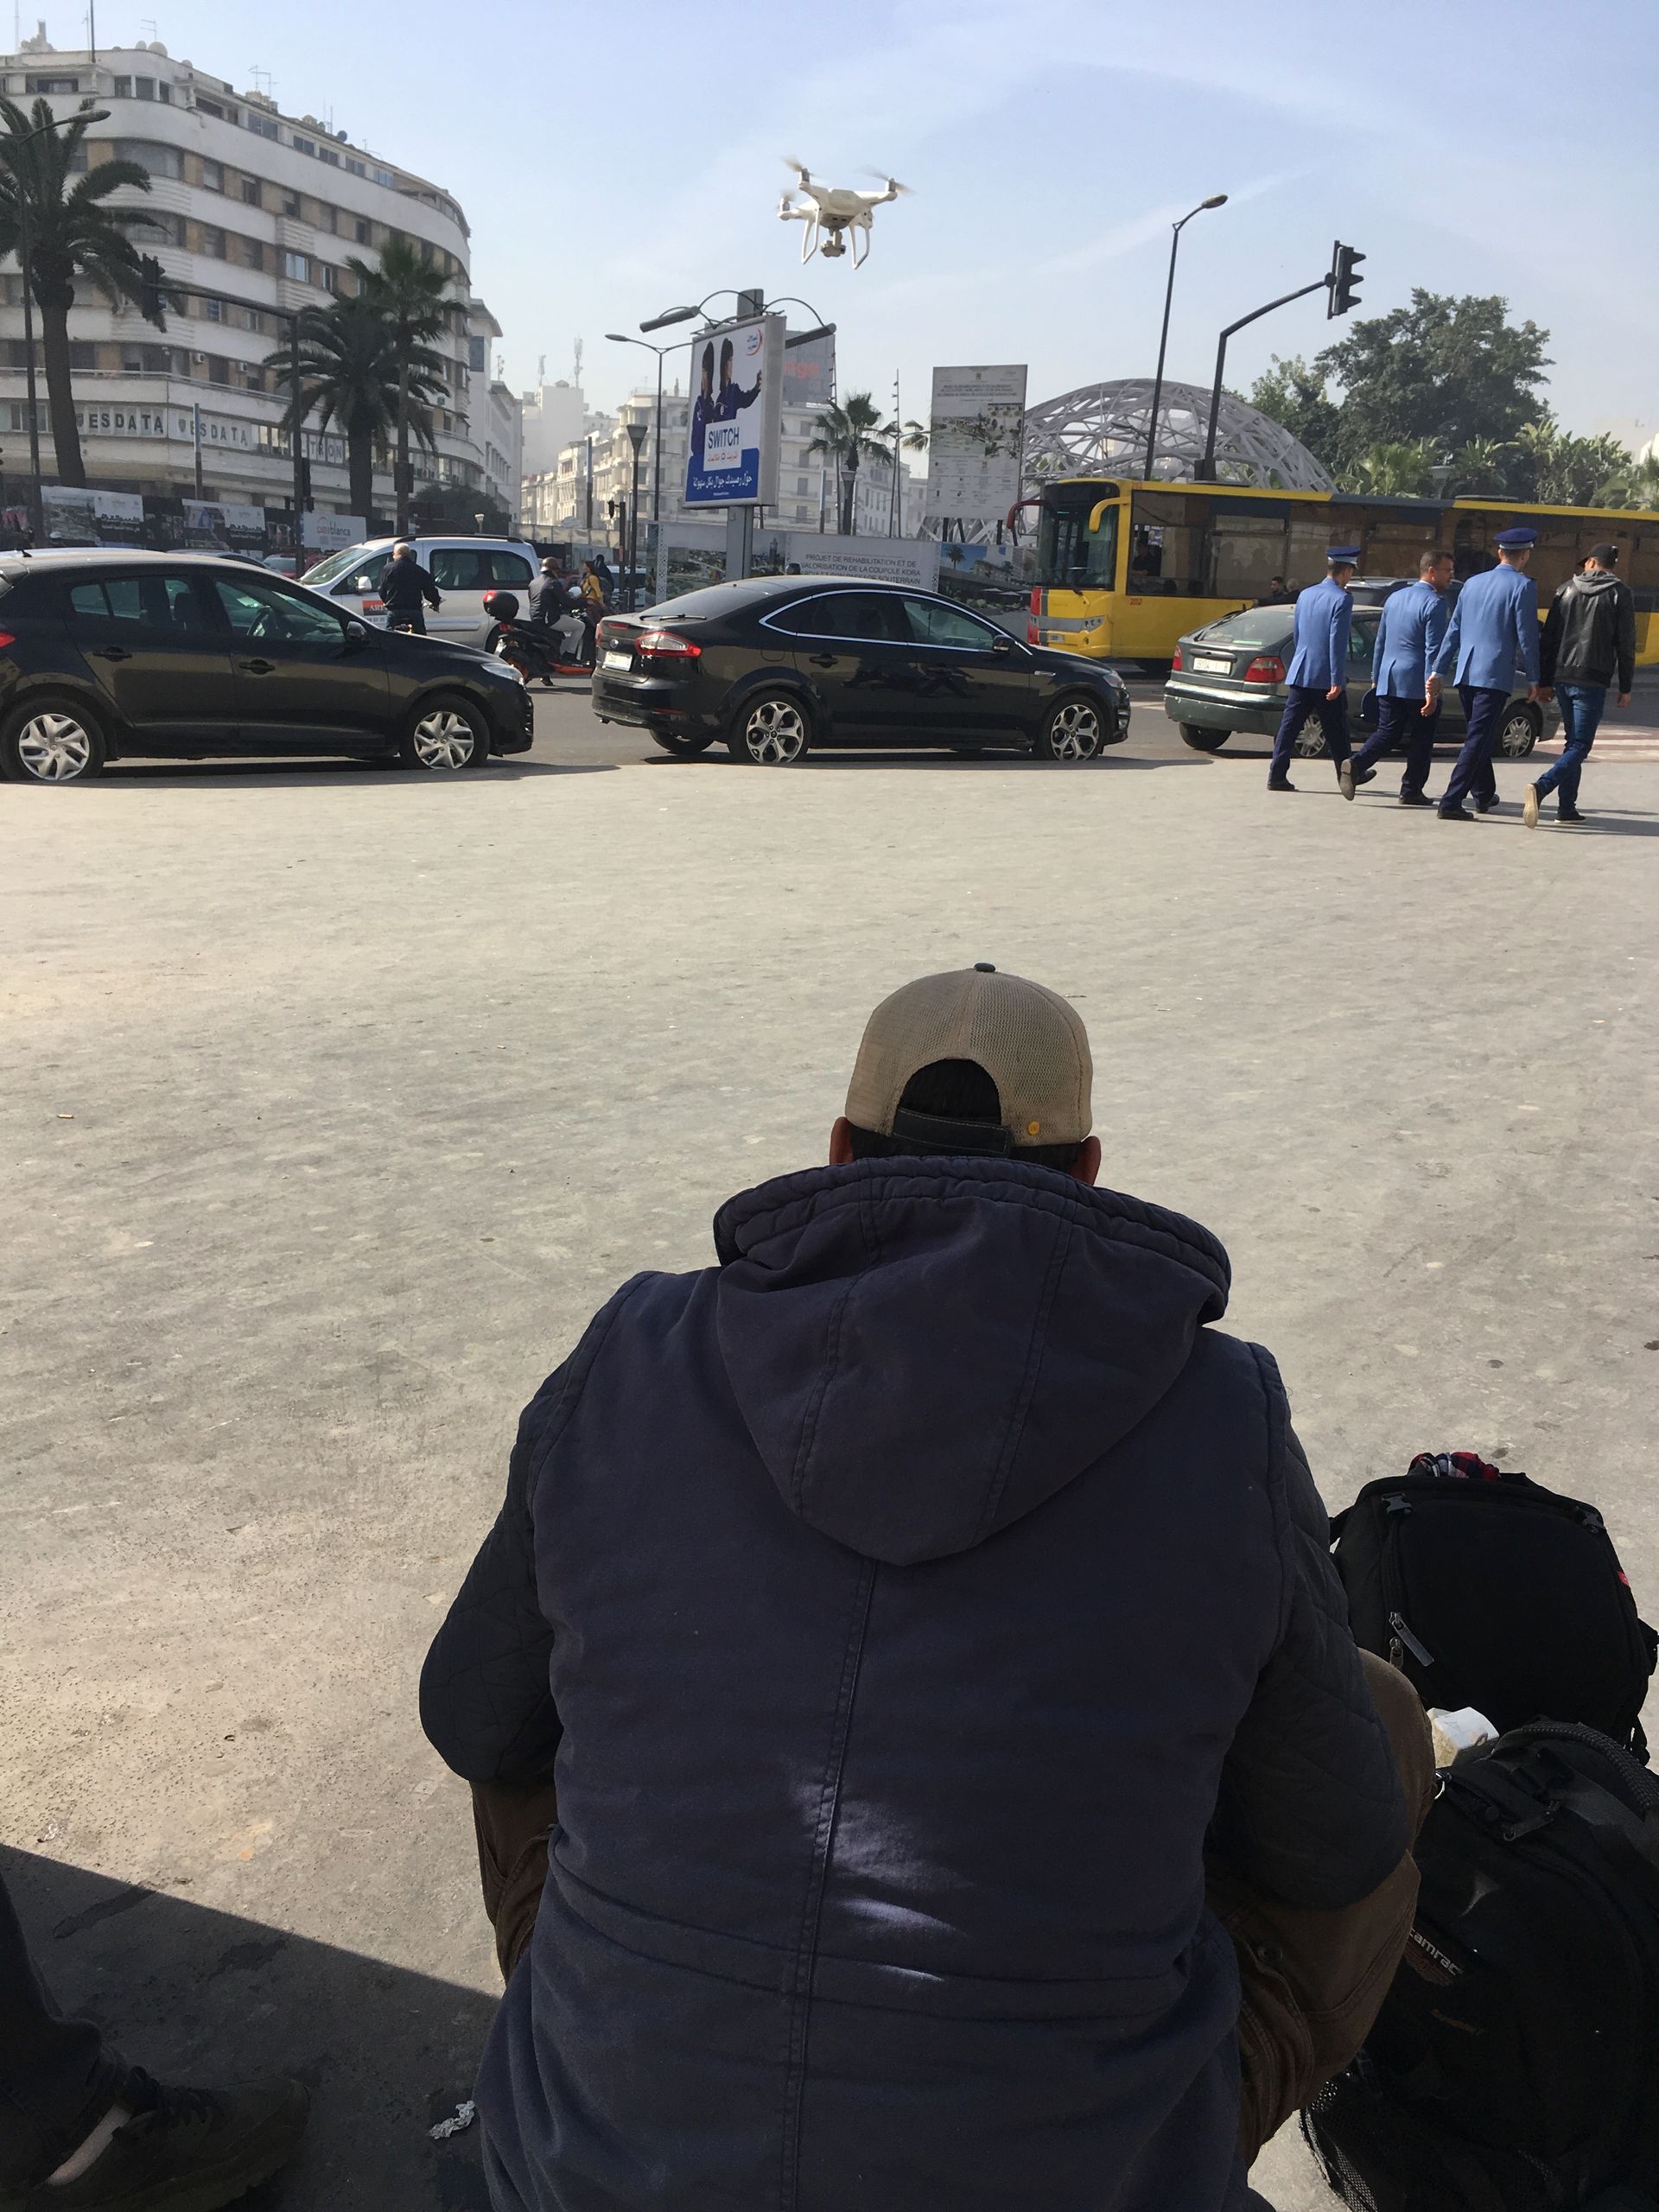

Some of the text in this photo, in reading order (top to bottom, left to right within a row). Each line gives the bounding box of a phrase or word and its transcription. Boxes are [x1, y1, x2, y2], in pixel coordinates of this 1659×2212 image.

[88, 413, 164, 434] ESDATA
[708, 427, 740, 449] SWITCH
[868, 566, 902, 575] COUPOLE
[902, 568, 921, 576] KORA
